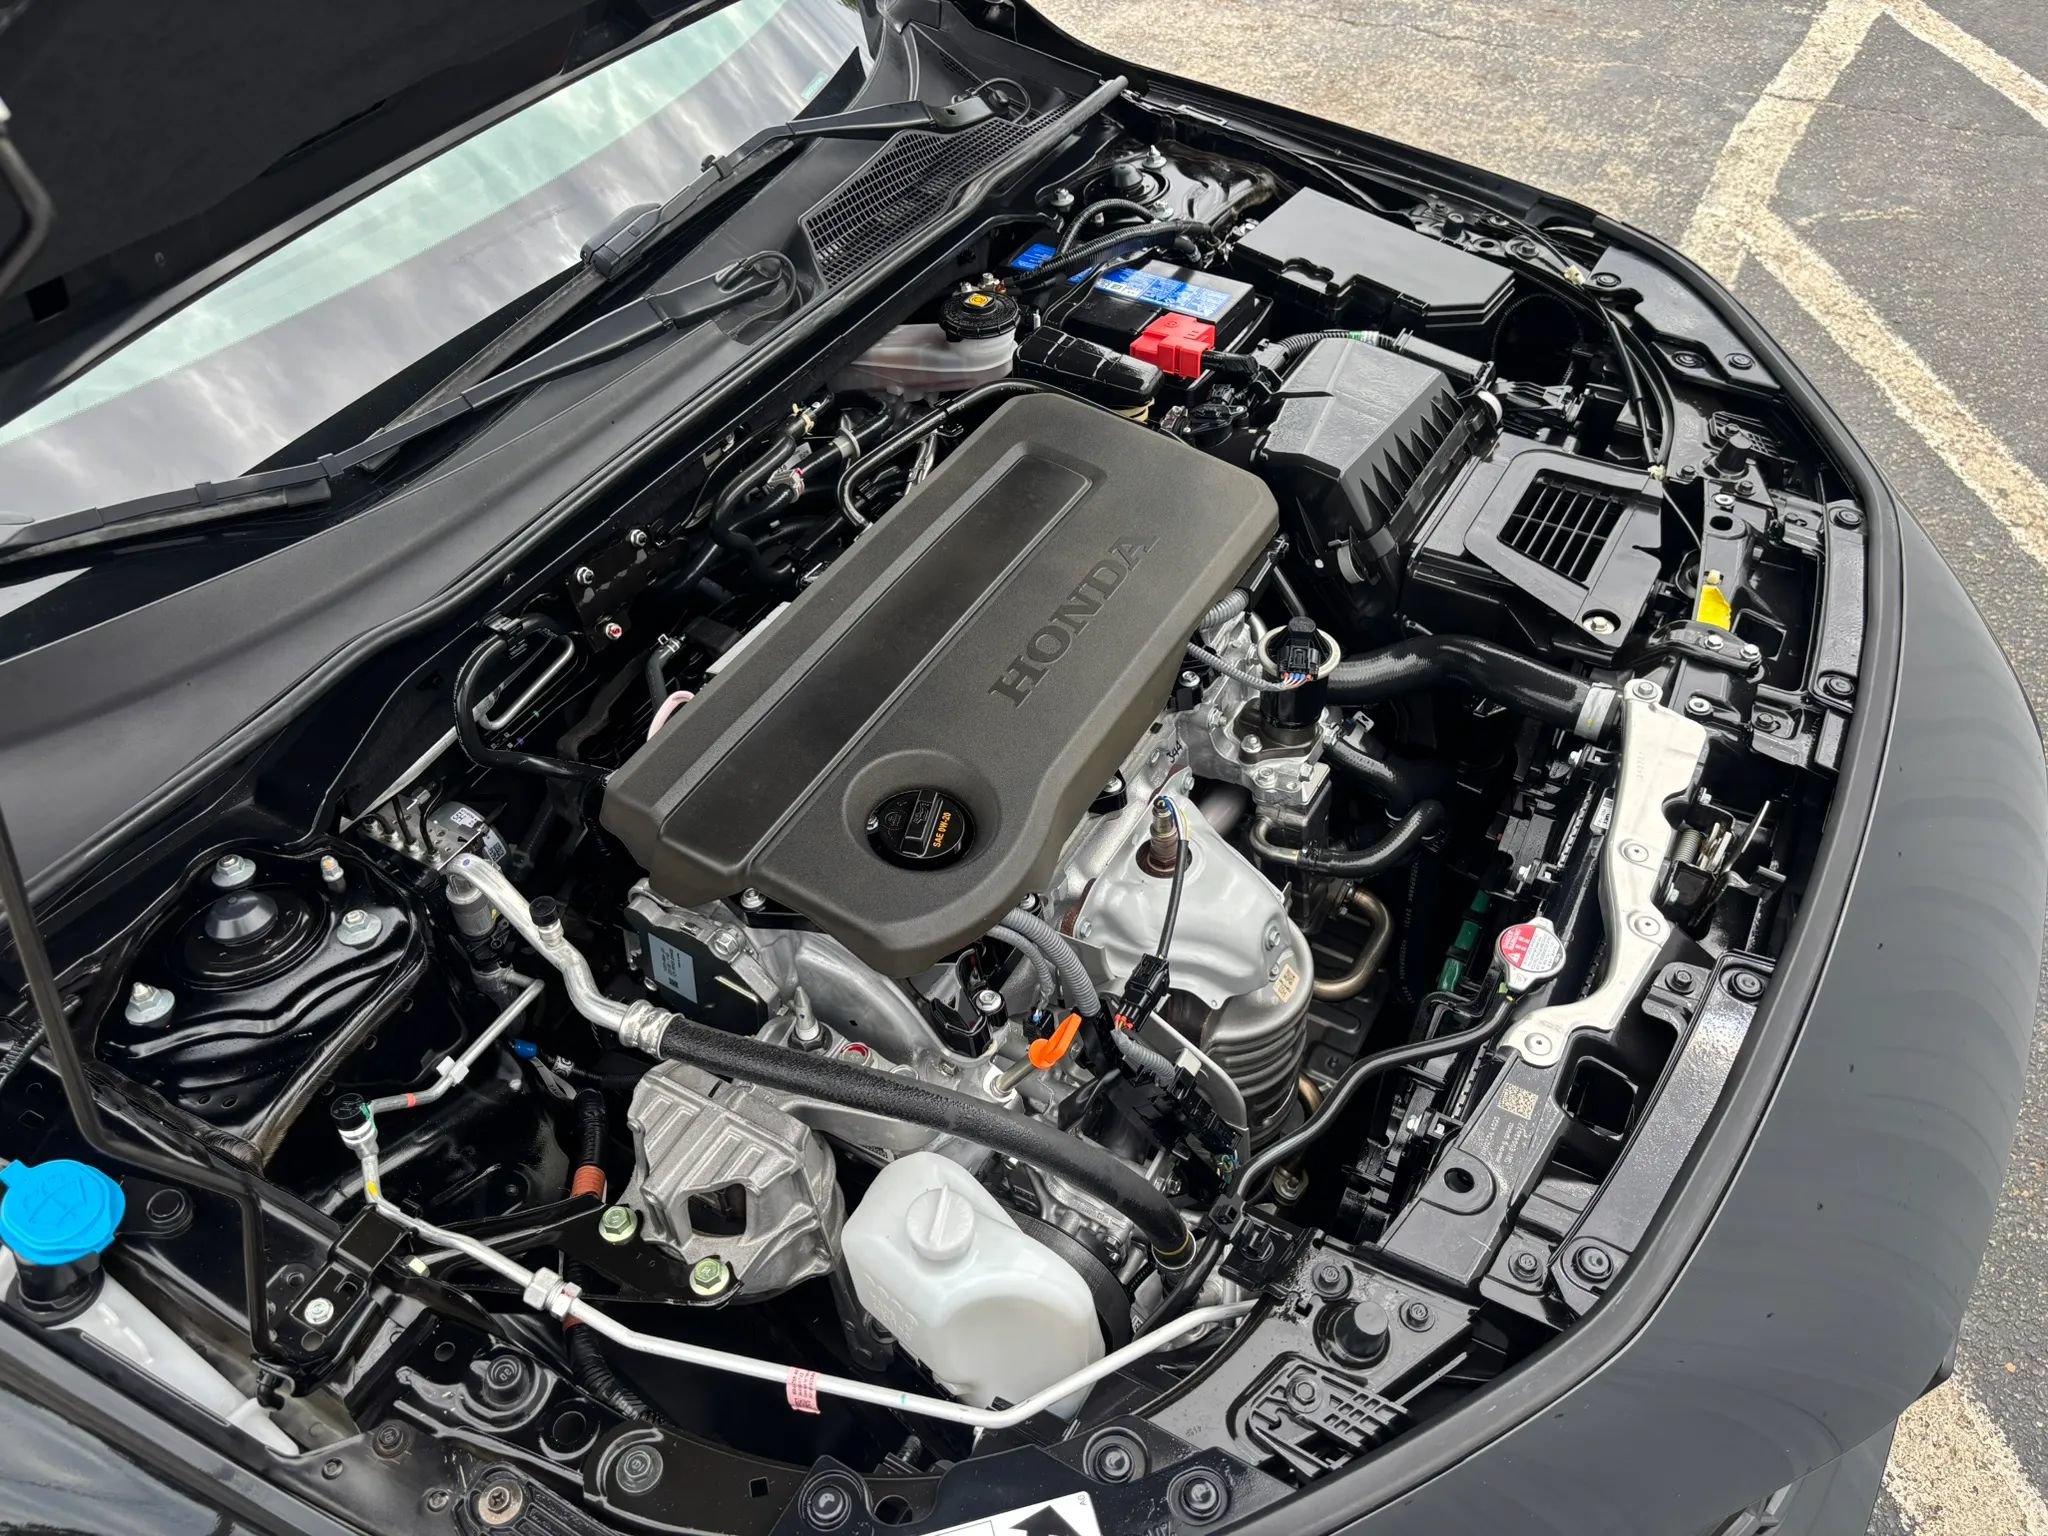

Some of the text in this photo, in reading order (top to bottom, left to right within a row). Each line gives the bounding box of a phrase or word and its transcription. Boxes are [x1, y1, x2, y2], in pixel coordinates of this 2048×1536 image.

[988, 536, 1160, 709] HONDA
[933, 812, 951, 848] SAE 0W-20
